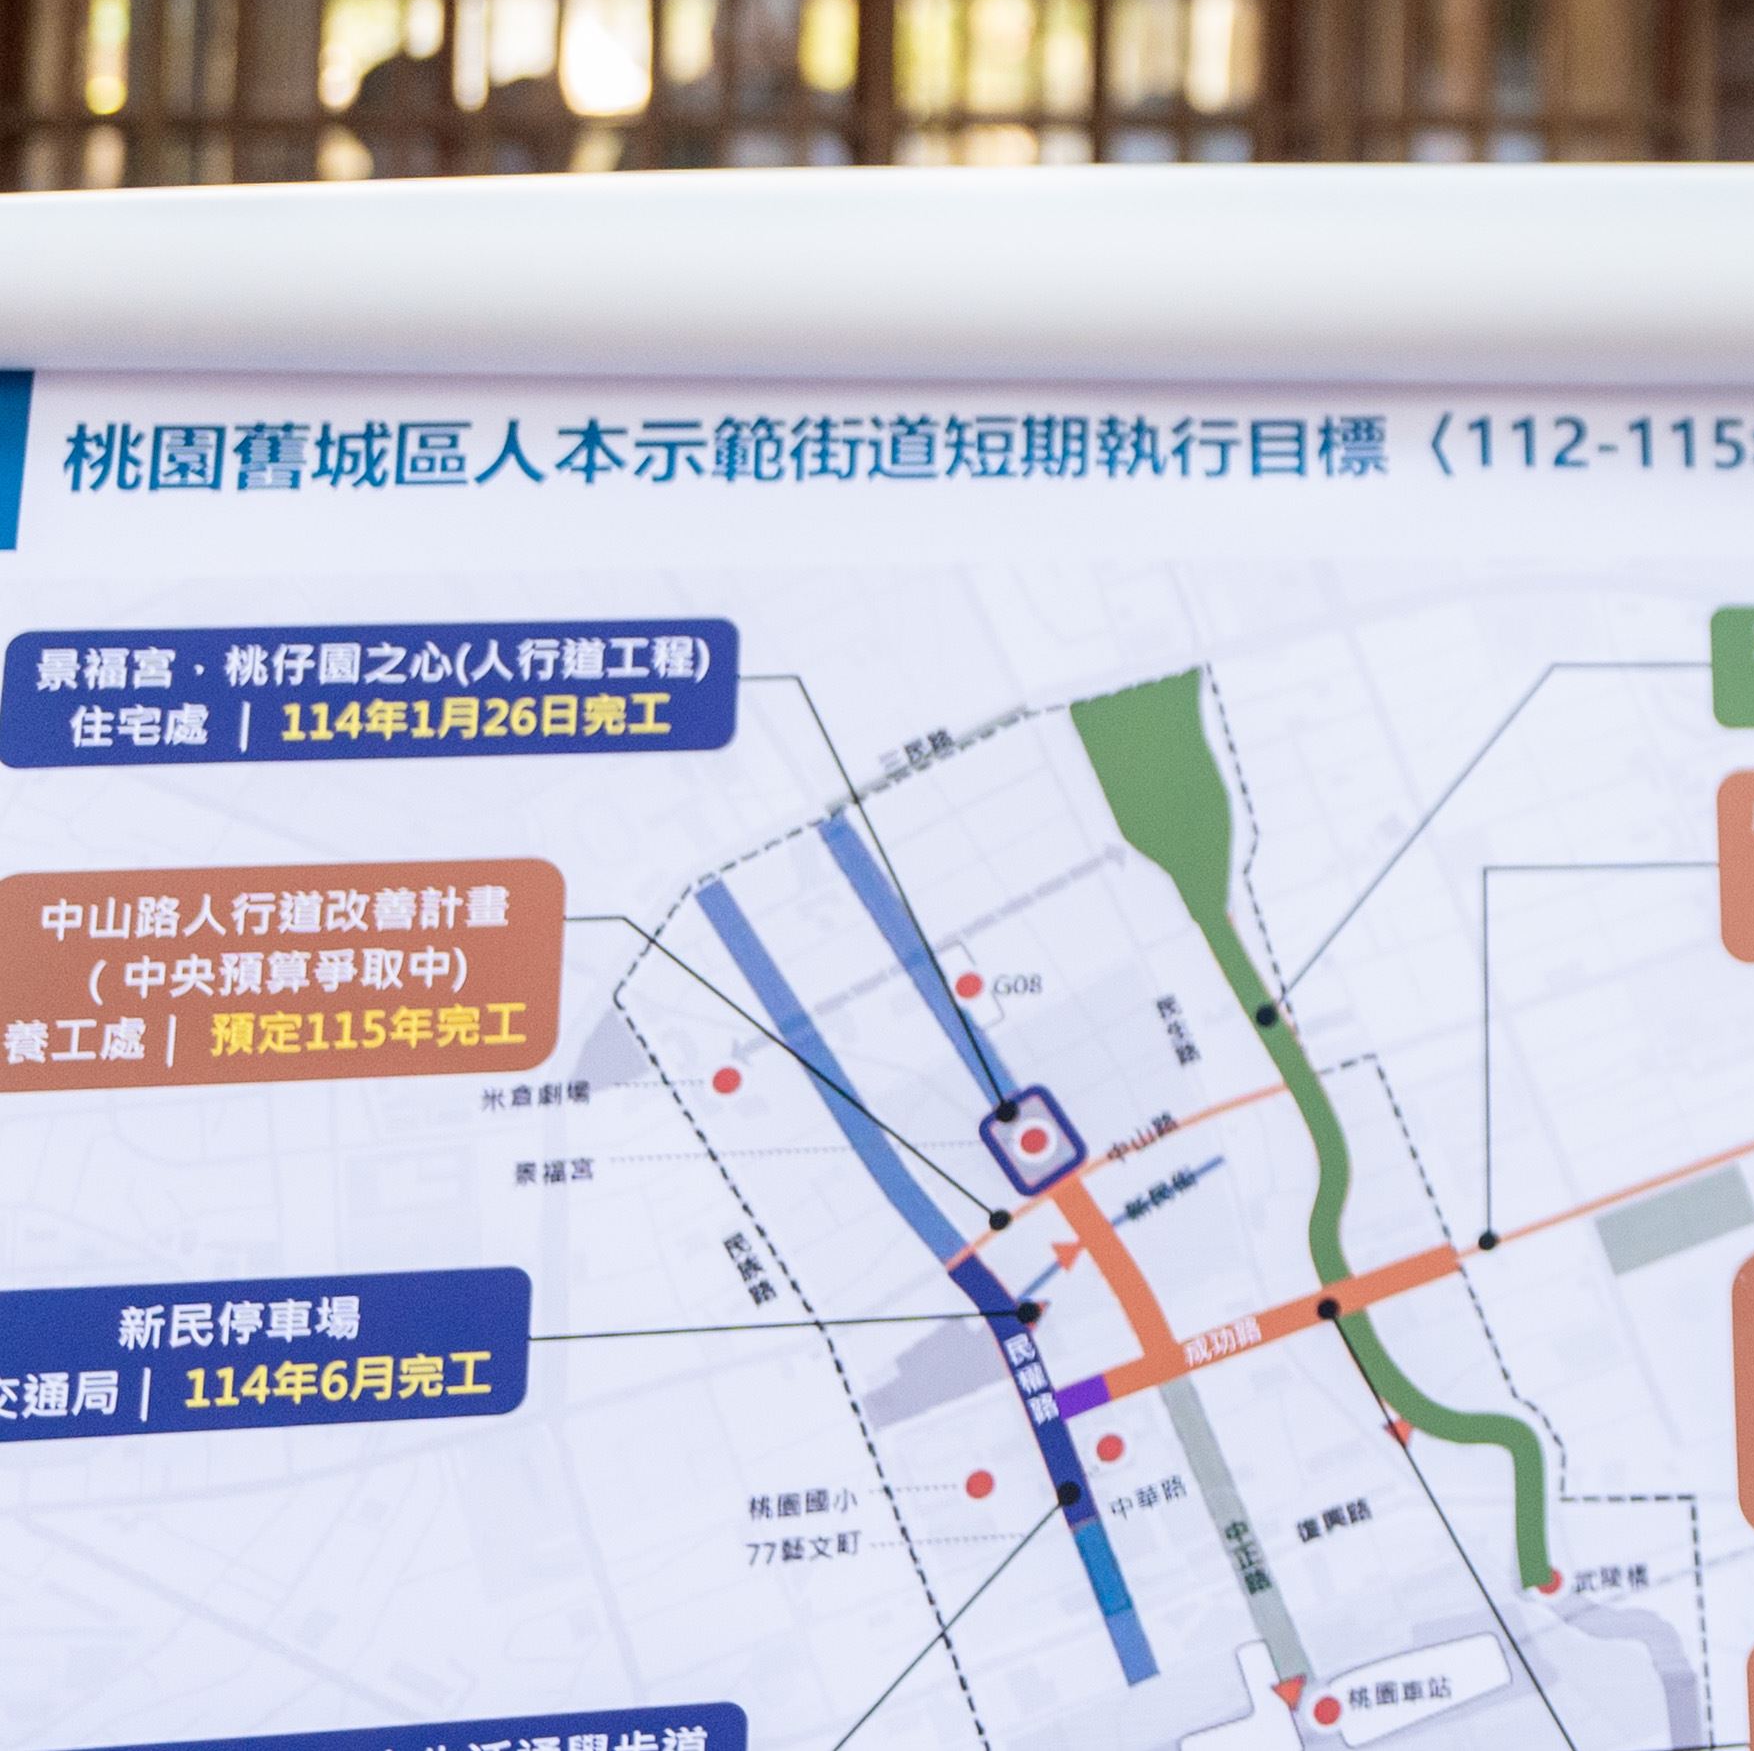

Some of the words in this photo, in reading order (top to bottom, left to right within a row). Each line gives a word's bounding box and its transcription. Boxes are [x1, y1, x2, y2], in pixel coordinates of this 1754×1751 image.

[69, 703, 208, 748] 住宅處
[280, 692, 671, 742] 114年1月26日完工
[41, 886, 511, 942] 中山路人行道改善計畫
[211, 1002, 527, 1058] 預定115年完工
[119, 1295, 361, 1350] 新民停車場
[185, 1351, 493, 1408] 114年6月完工
[750, 1488, 858, 1519] 桃園國小
[1349, 1676, 1452, 1709] 桃園車站
